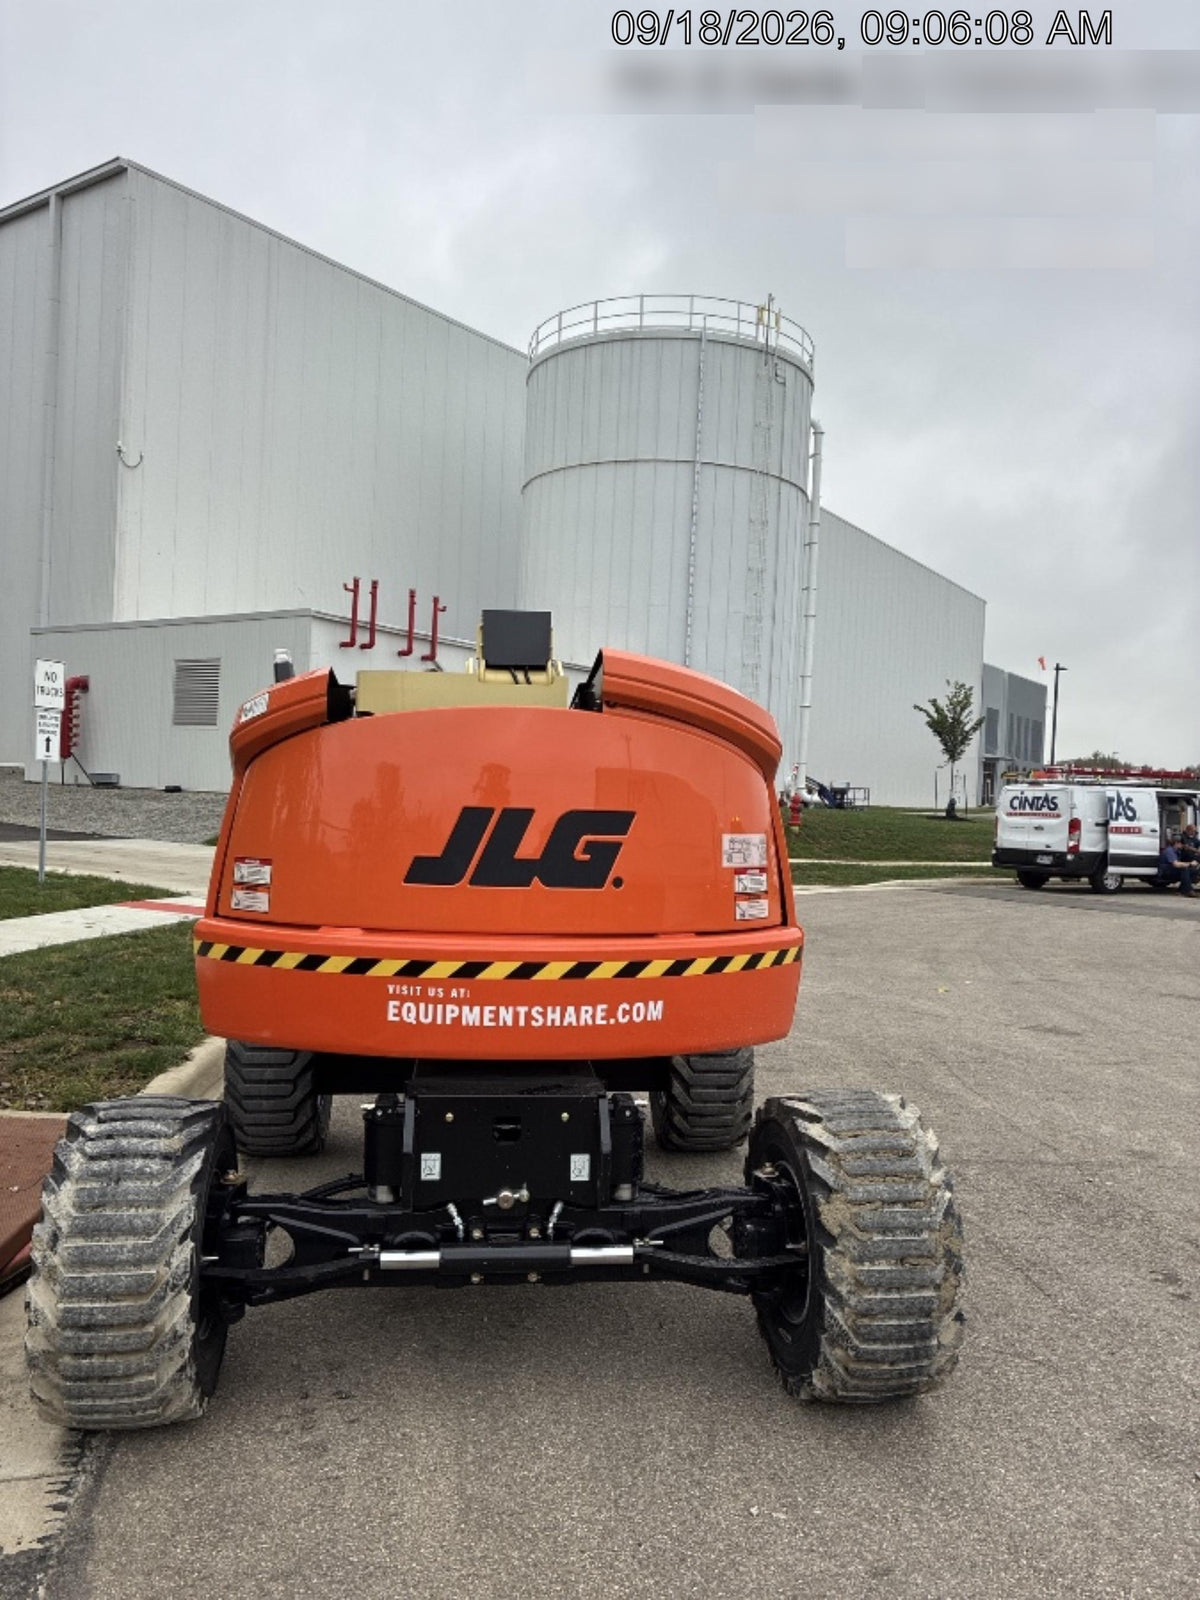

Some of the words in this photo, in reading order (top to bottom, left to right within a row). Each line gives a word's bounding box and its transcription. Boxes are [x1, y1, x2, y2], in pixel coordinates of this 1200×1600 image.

[44, 671, 58, 683] NO
[387, 984, 422, 996] VISIT
[427, 987, 444, 997] US
[450, 988, 471, 998] AT:
[387, 1000, 663, 1027] EQUIPMENTSHARE.COM
